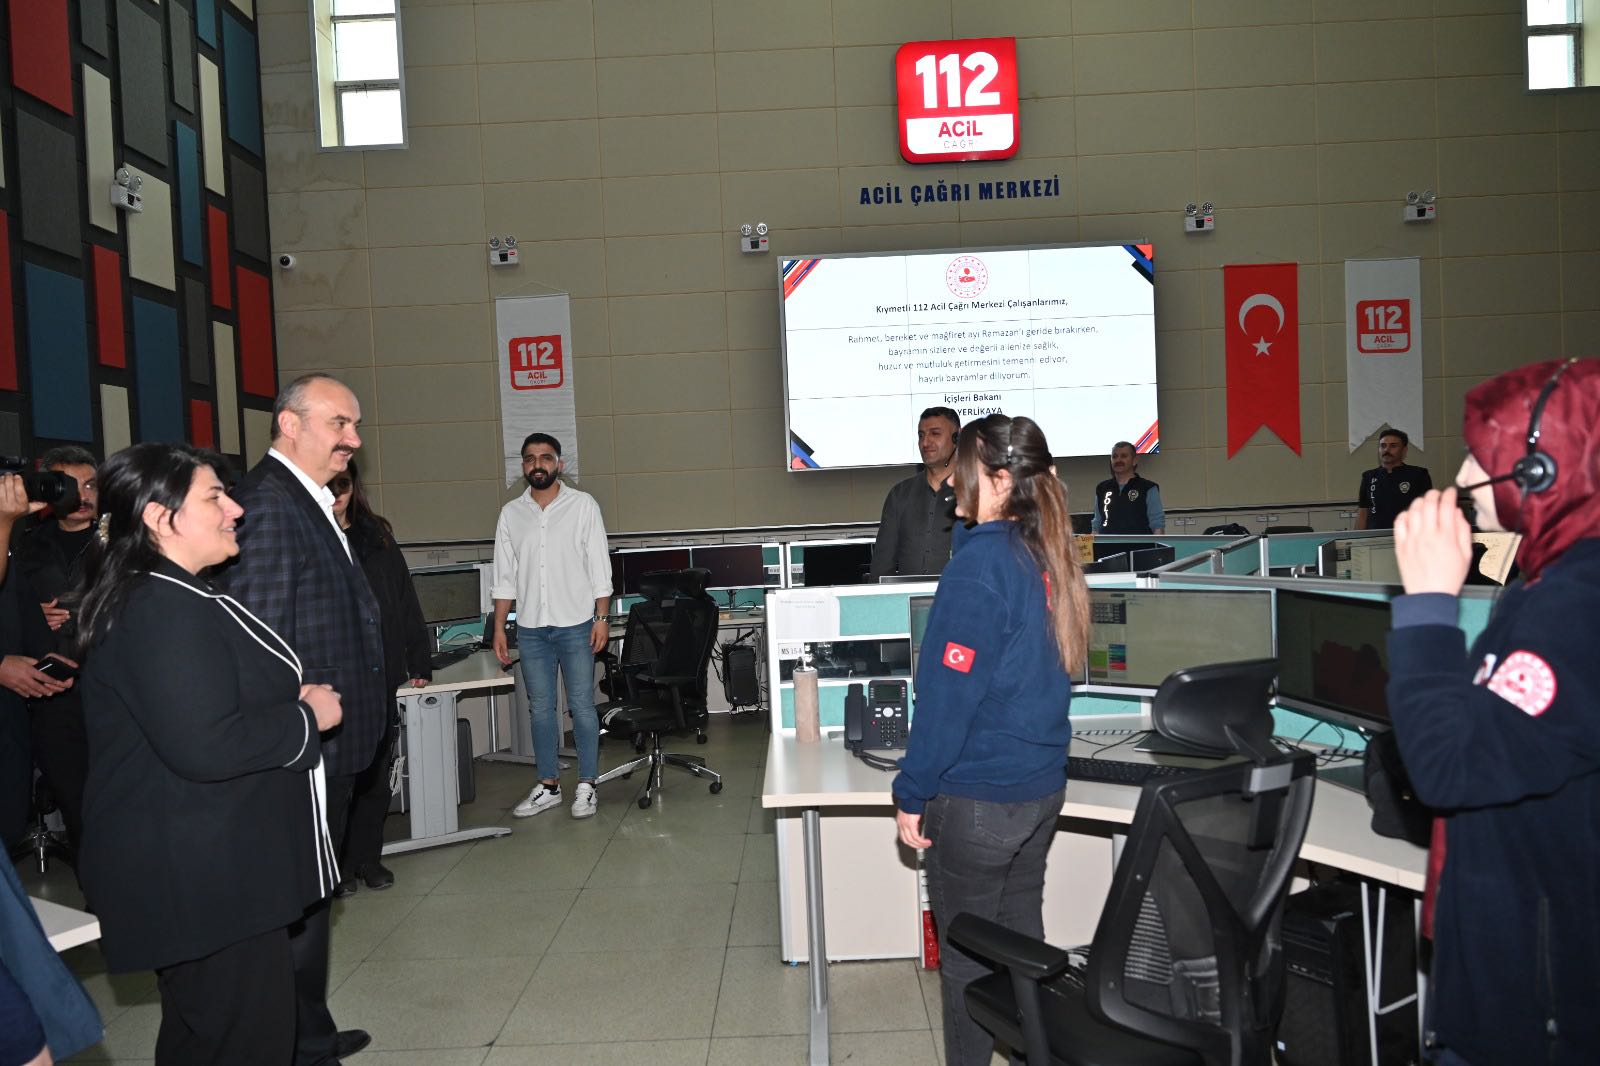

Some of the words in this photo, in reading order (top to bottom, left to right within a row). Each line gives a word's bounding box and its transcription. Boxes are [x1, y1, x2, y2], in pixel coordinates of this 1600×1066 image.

[915, 51, 1001, 109] 112
[860, 182, 902, 205] ACİL
[910, 180, 970, 206] ÇAĞRI
[978, 174, 1060, 200] MERKEZİ
[913, 303, 928, 312] 112
[930, 302, 946, 311] Acil
[948, 301, 969, 311] Çağrı
[971, 299, 1005, 308] Merkezi
[1364, 305, 1403, 330] 112
[885, 333, 917, 342] bereket
[1026, 326, 1052, 337] geride
[517, 341, 555, 367] 112
[929, 346, 956, 354] sizlere
[878, 362, 902, 371] huzur
[973, 393, 1002, 402] Bakanı
[957, 406, 1003, 416] YERLİKAYA
